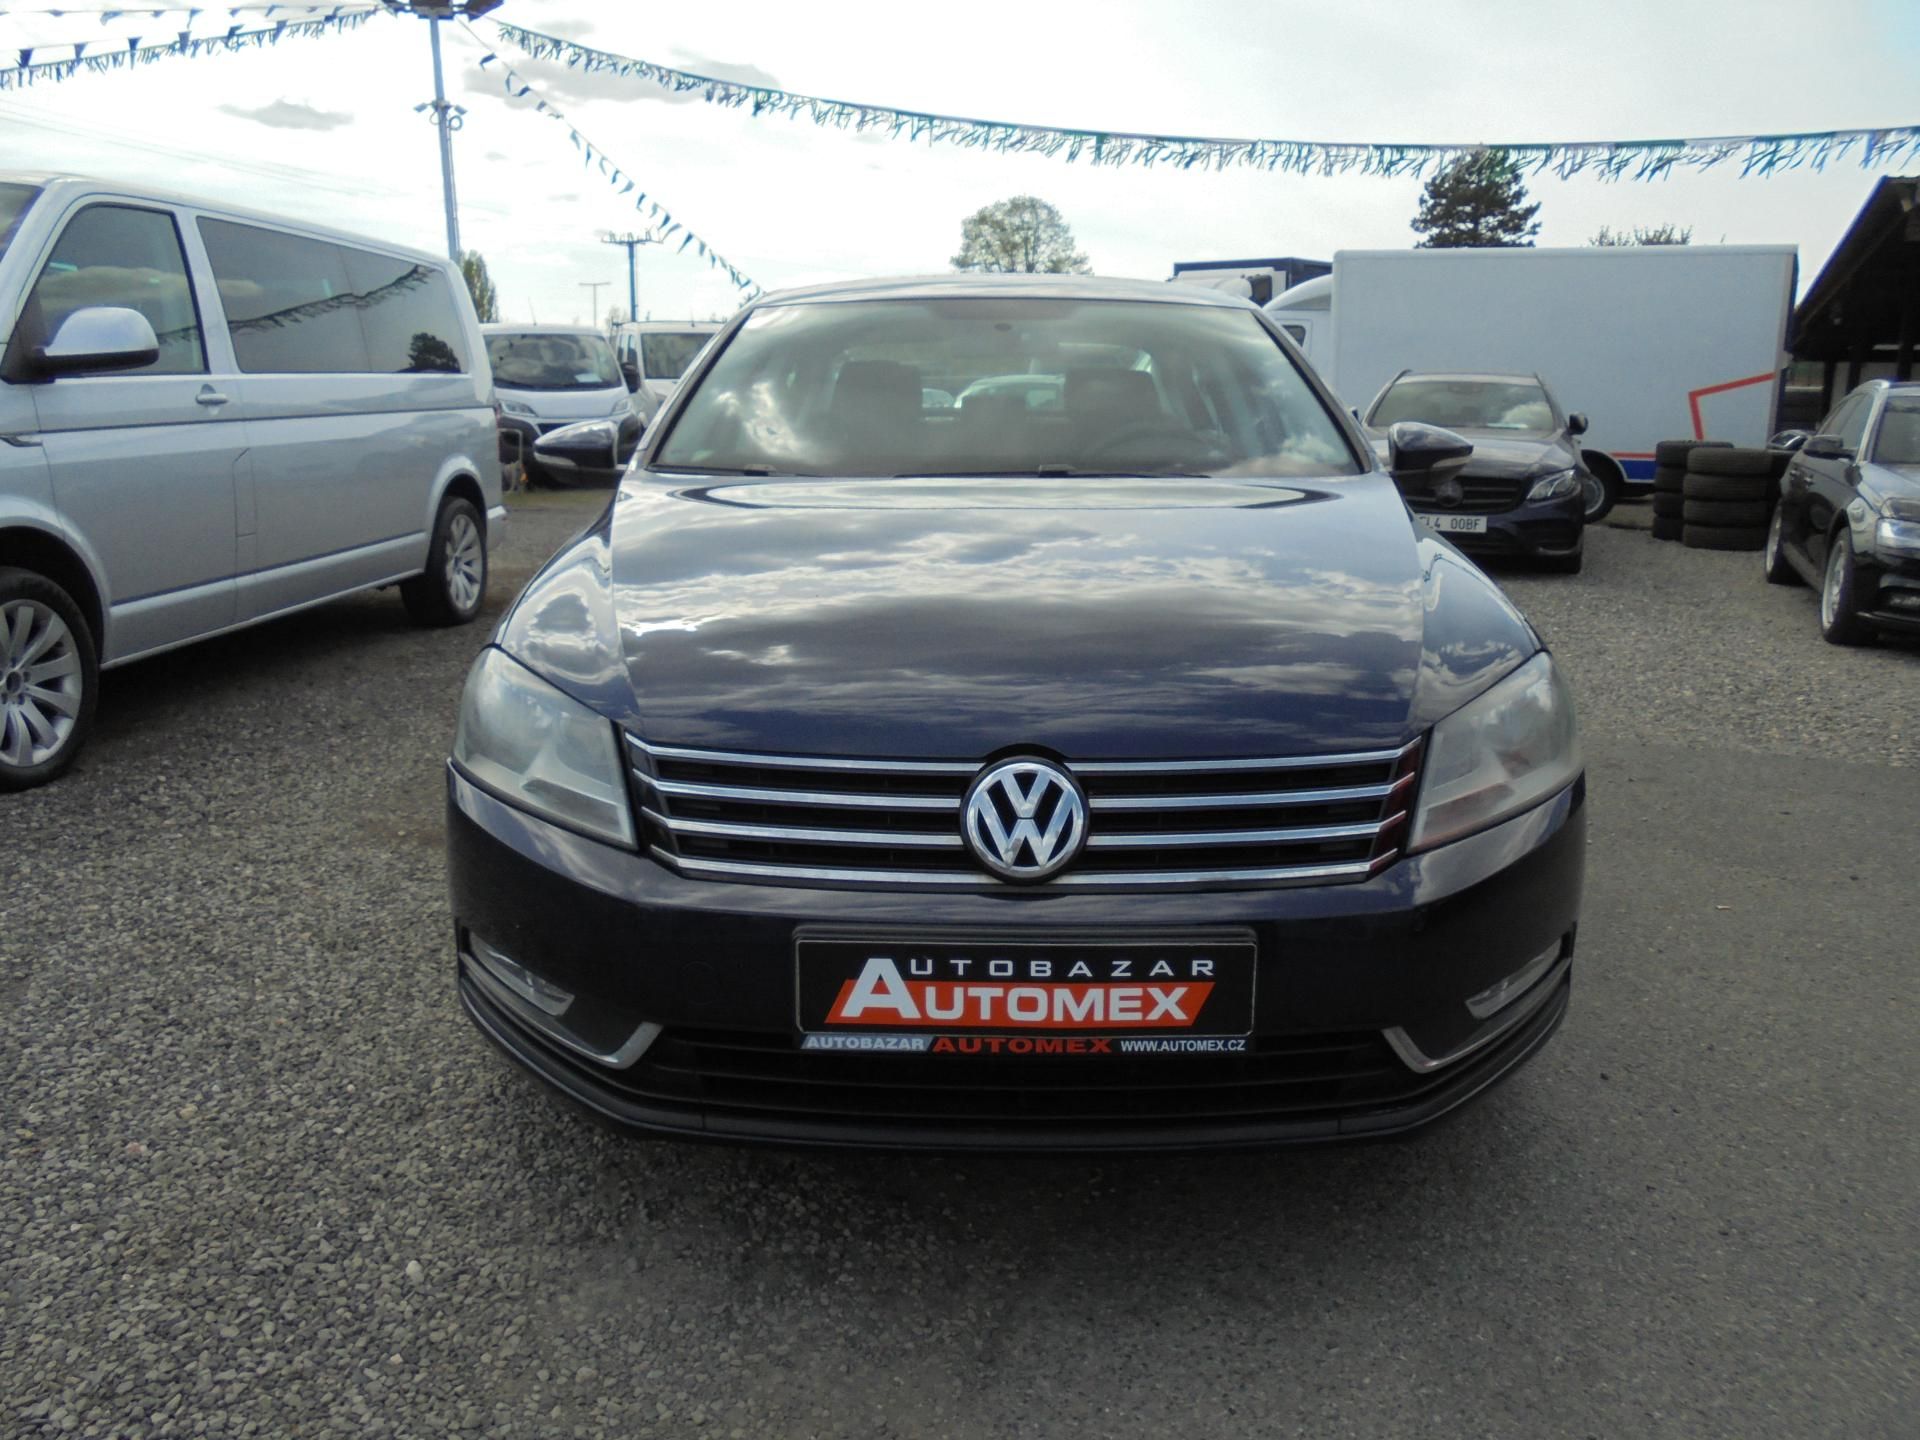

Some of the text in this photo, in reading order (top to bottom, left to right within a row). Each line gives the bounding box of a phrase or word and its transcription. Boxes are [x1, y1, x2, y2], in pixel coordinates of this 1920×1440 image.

[840, 957, 1188, 1021] AUTOMEX
[806, 1036, 1245, 1053] AUTOBAZAR AUTOMEX WWW.AUTOMEX.CZ
